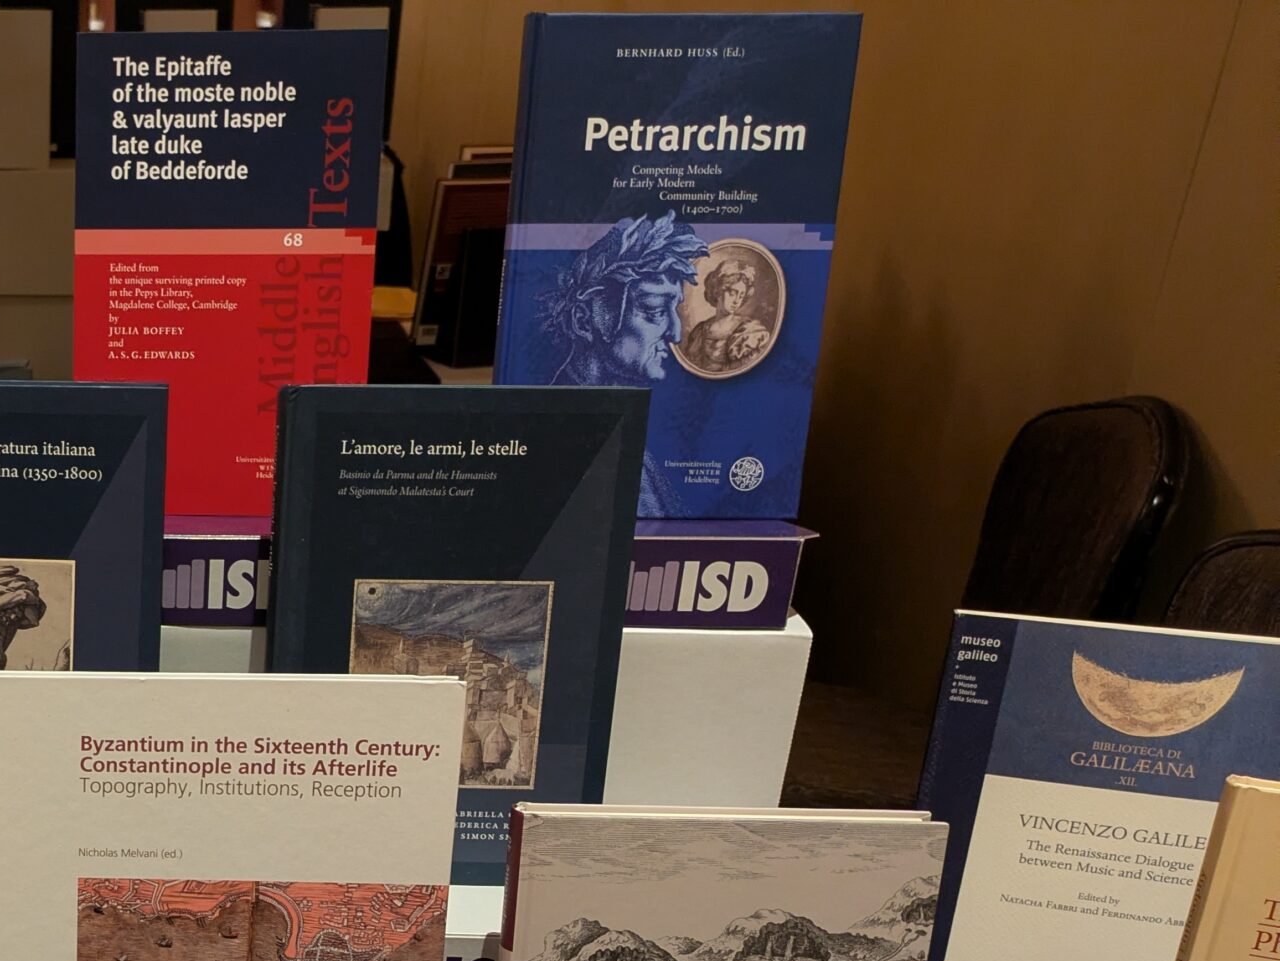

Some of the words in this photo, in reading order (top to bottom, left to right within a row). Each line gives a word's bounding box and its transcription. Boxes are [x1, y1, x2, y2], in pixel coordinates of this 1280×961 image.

[617, 49, 682, 57] BERNHARD
[688, 49, 718, 57] HUSS
[723, 48, 745, 58] (Ed.)
[113, 57, 149, 76] The
[155, 56, 231, 81] Epitaffe
[112, 83, 132, 102] of
[137, 83, 168, 102] the
[175, 84, 234, 102] moste
[241, 82, 296, 101] noble
[112, 111, 127, 129] &
[134, 110, 218, 133] valyaunt
[585, 115, 806, 151] Petrarchism
[112, 135, 149, 154] late
[155, 135, 202, 154] duke
[111, 161, 131, 179] of
[136, 160, 248, 179] Beddeforde
[307, 97, 354, 227] Texts
[632, 165, 684, 176] Competing
[687, 165, 722, 175] Models
[659, 191, 715, 202] Community
[718, 191, 758, 202] Building
[283, 234, 303, 246] 68
[109, 301, 154, 310] Magdalene
[157, 300, 190, 310] College,
[192, 300, 237, 310] Cambridge
[108, 327, 139, 336] JULIA
[143, 327, 184, 335] BOFFEY
[43, 440, 95, 456] italiana
[410, 440, 423, 455] le
[427, 441, 466, 458] armi,
[470, 441, 484, 455] le
[488, 441, 527, 456] stelle
[339, 469, 370, 480] Basinio
[373, 470, 383, 480] da
[387, 470, 414, 480] Parma
[417, 470, 431, 481] and
[435, 470, 448, 481] the
[451, 470, 497, 481] Humanists
[678, 561, 769, 612] ISD
[961, 635, 1001, 648] museo
[957, 649, 998, 663] galileo
[81, 736, 184, 754] Byzantium
[192, 737, 208, 752] in
[215, 737, 247, 754] the
[254, 737, 347, 755] Sixteenth
[355, 739, 440, 760] Century:
[1093, 742, 1164, 757] BIBLIOTECA
[1168, 750, 1181, 758] DI
[80, 757, 231, 777] Constantinople
[239, 759, 276, 775] and
[283, 760, 306, 776] its
[313, 759, 398, 777] Afterlife
[1071, 752, 1195, 779] GALILÆANA
[1019, 814, 1127, 840] VINCENZO
[79, 848, 118, 858] Nicholas
[121, 849, 158, 858] Melvani
[161, 849, 182, 860] (ed.)
[1026, 839, 1051, 853] The
[1055, 843, 1131, 863] Renaissance
[1135, 854, 1194, 872] Dialogue
